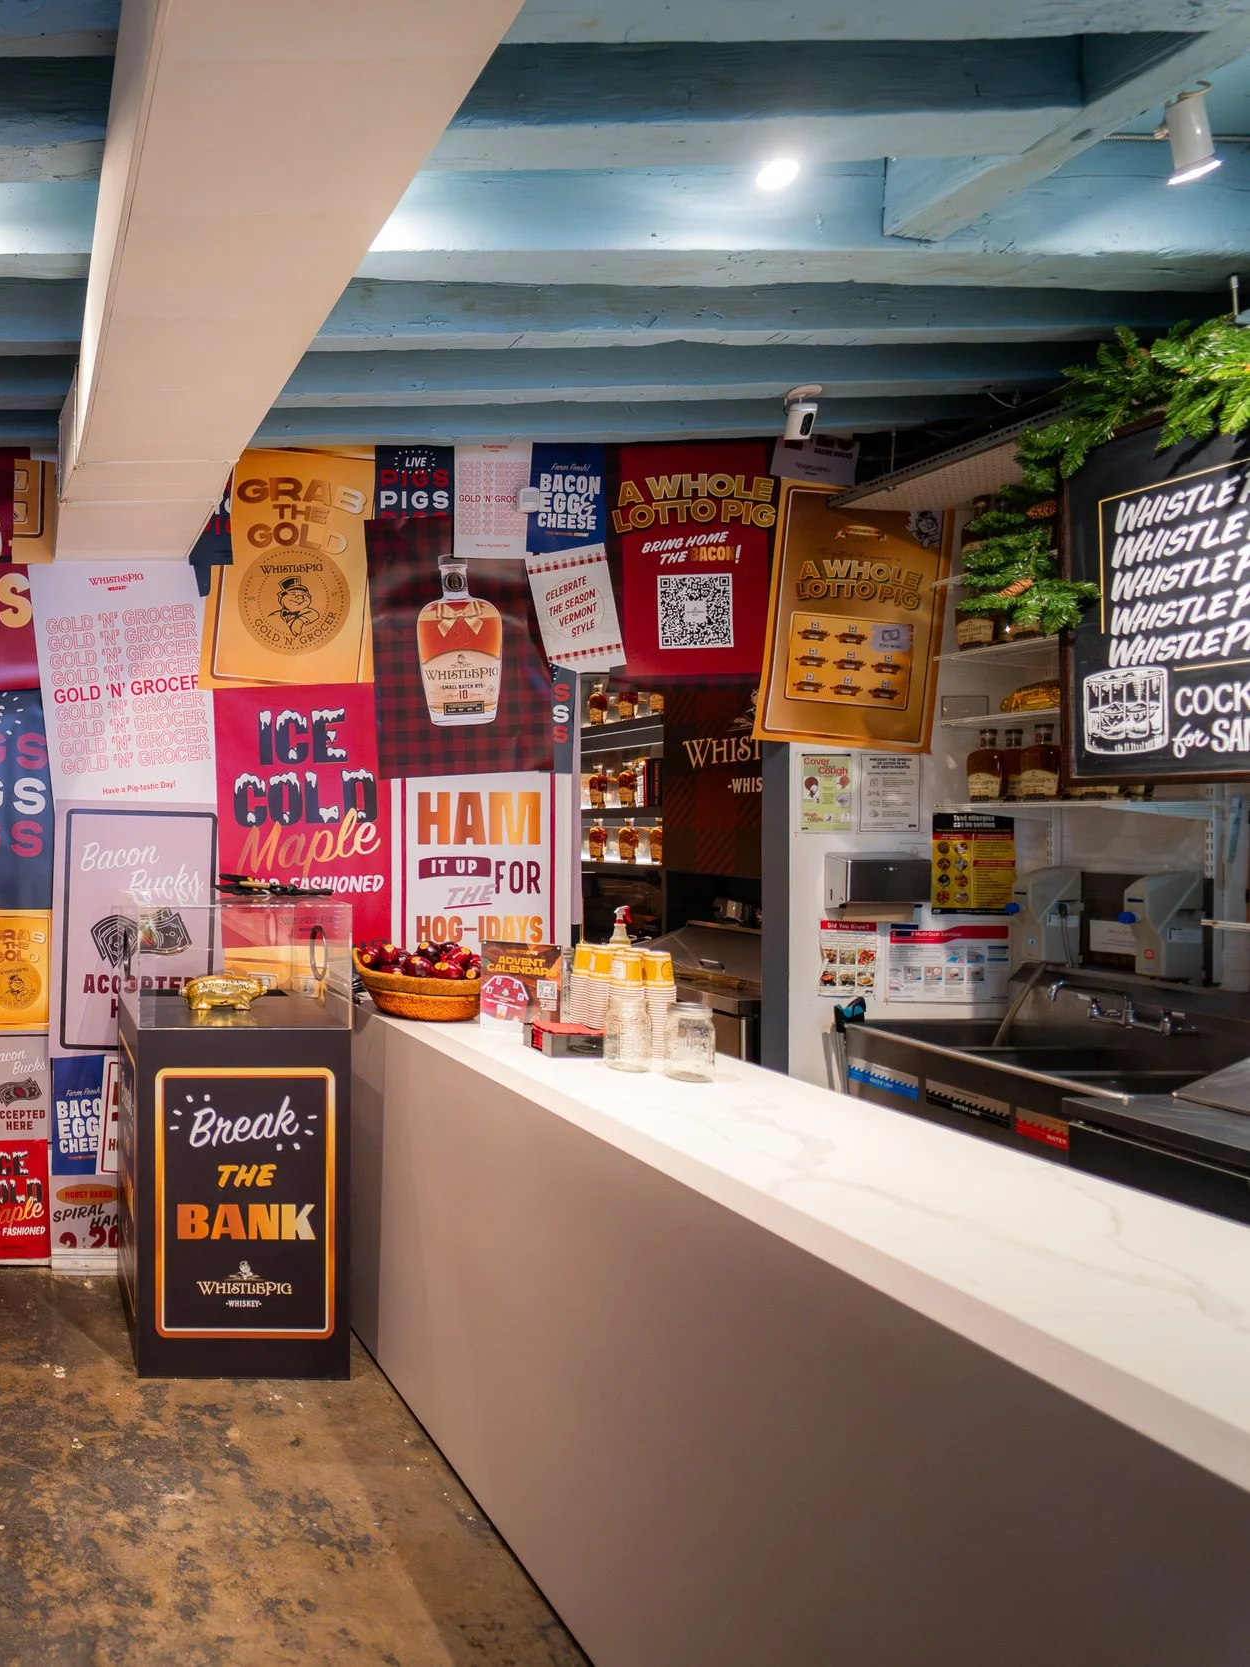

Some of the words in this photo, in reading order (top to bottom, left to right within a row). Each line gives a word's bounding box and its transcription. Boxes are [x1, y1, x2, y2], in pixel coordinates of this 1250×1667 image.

[404, 455, 428, 468] LIVE
[551, 462, 569, 471] Farm
[568, 463, 592, 472] Fresh!
[379, 469, 450, 488] PIGS
[539, 473, 602, 495] BACON
[618, 479, 644, 506] A
[645, 472, 775, 502] WHOLE
[236, 476, 369, 516] GRAB
[379, 490, 450, 509] PIGS
[538, 492, 581, 514] EGG
[1114, 475, 1241, 534] WHISTLE
[272, 503, 331, 526] THE
[537, 512, 597, 531] CHEESE
[612, 499, 718, 534] LOTTO
[721, 503, 777, 529] PIG
[246, 521, 350, 555] GOLD
[641, 536, 685, 554] BRING
[685, 531, 730, 547] HOME
[1110, 510, 1249, 569] WHISTLE
[659, 550, 689, 566] THE
[690, 545, 742, 565] BACON!
[88, 572, 145, 586] WHISTLEPIG
[259, 562, 325, 576] WHISTLEPIG
[800, 560, 821, 580] A
[822, 559, 922, 590] WHOLE
[1110, 550, 1236, 603] WHISTLE
[544, 575, 588, 602] CELEBRATE
[794, 578, 876, 601] LOTTO
[878, 583, 921, 610] PIG
[548, 603, 564, 618] THE
[564, 588, 597, 611] SEASON
[1110, 589, 1234, 637] WHISTLE
[46, 615, 93, 634] GOLD
[122, 603, 196, 626] GROCER
[558, 603, 598, 628] VERMONT
[48, 632, 95, 652] GOLD
[124, 621, 198, 644] GROCER
[571, 619, 596, 639] STYLE
[52, 667, 99, 687] GOLD
[128, 656, 200, 679] GROCER
[424, 666, 499, 681] WHISTLEPIG
[54, 685, 101, 704] GOLD
[57, 720, 105, 740] GOLD
[134, 709, 208, 731] GROCER
[258, 706, 348, 766] ICE
[61, 754, 109, 775] GOLD
[137, 744, 212, 766] GROCER
[803, 757, 831, 766] Cover
[817, 766, 849, 777] Cough
[102, 786, 119, 796] Have
[126, 782, 160, 795] Pig-tastic
[160, 780, 177, 790] Day!
[233, 768, 379, 828] COLD
[417, 791, 542, 846] HAM
[236, 807, 382, 878] Maple
[79, 841, 160, 873] Bacon
[430, 859, 446, 874] IT
[455, 859, 479, 875] UP
[494, 860, 542, 895] FOR
[447, 884, 496, 904] THE
[415, 915, 544, 944] HOG-IDAYS
[2, 941, 30, 950] THE
[486, 963, 559, 977] CALENDARS
[497, 955, 546, 967] ADVENT
[11, 1059, 48, 1076] Bucks
[951, 1102, 968, 1113] WATER
[5, 1120, 34, 1131] HERE
[187, 1095, 300, 1148] Break
[1046, 1134, 1067, 1145] WATER
[216, 1163, 278, 1189] THE
[52, 1203, 106, 1223] SPIRAL
[176, 1203, 317, 1241] BANK
[1, 1225, 47, 1237] FASHIONED
[196, 1280, 293, 1297] WHISTLEPIG
